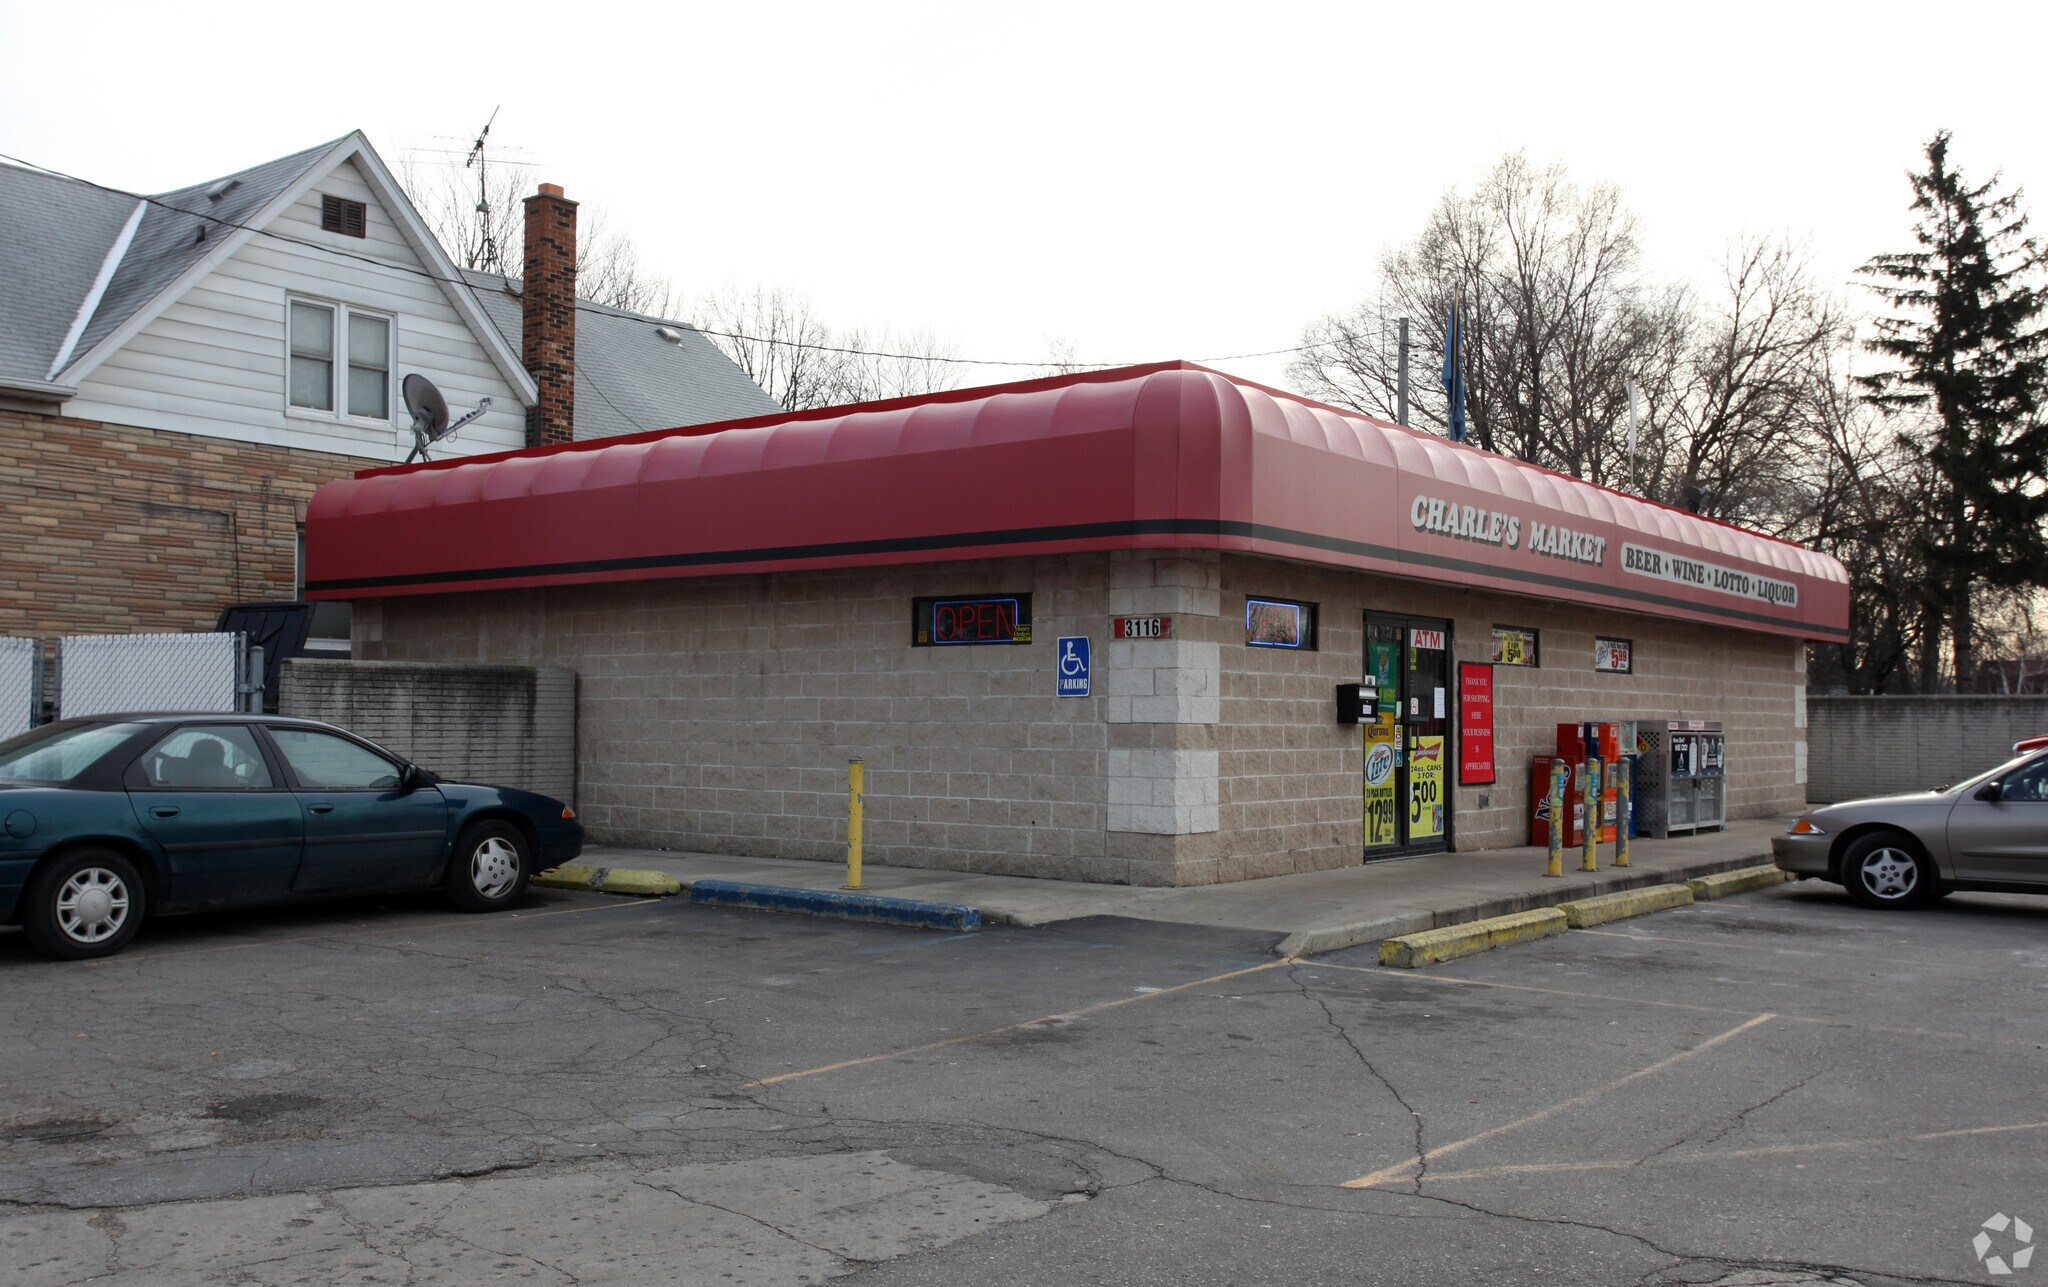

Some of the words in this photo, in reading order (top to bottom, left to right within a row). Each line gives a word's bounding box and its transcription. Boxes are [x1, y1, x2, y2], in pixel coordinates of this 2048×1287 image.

[1410, 495, 1520, 547] CHARLE'S
[1528, 521, 1606, 564] MARKET
[1625, 547, 1662, 575] BEER
[1672, 559, 1705, 584] WINE
[1714, 569, 1749, 594] LOTTO
[1757, 580, 1796, 605] LIQUOR
[936, 604, 1015, 640] OPEN
[1126, 619, 1159, 637] 3116
[1414, 630, 1441, 648] ATM
[1059, 678, 1087, 689] PARKING
[1465, 677, 1478, 686] THANK
[1479, 678, 1487, 686] YOU
[1463, 694, 1471, 702] FOR
[1471, 695, 1490, 703] SHOPPING
[1368, 725, 1389, 738] Corona
[1475, 745, 1480, 753] IS
[1371, 754, 1390, 781] Lite
[1465, 762, 1490, 770] APPRECIATED
